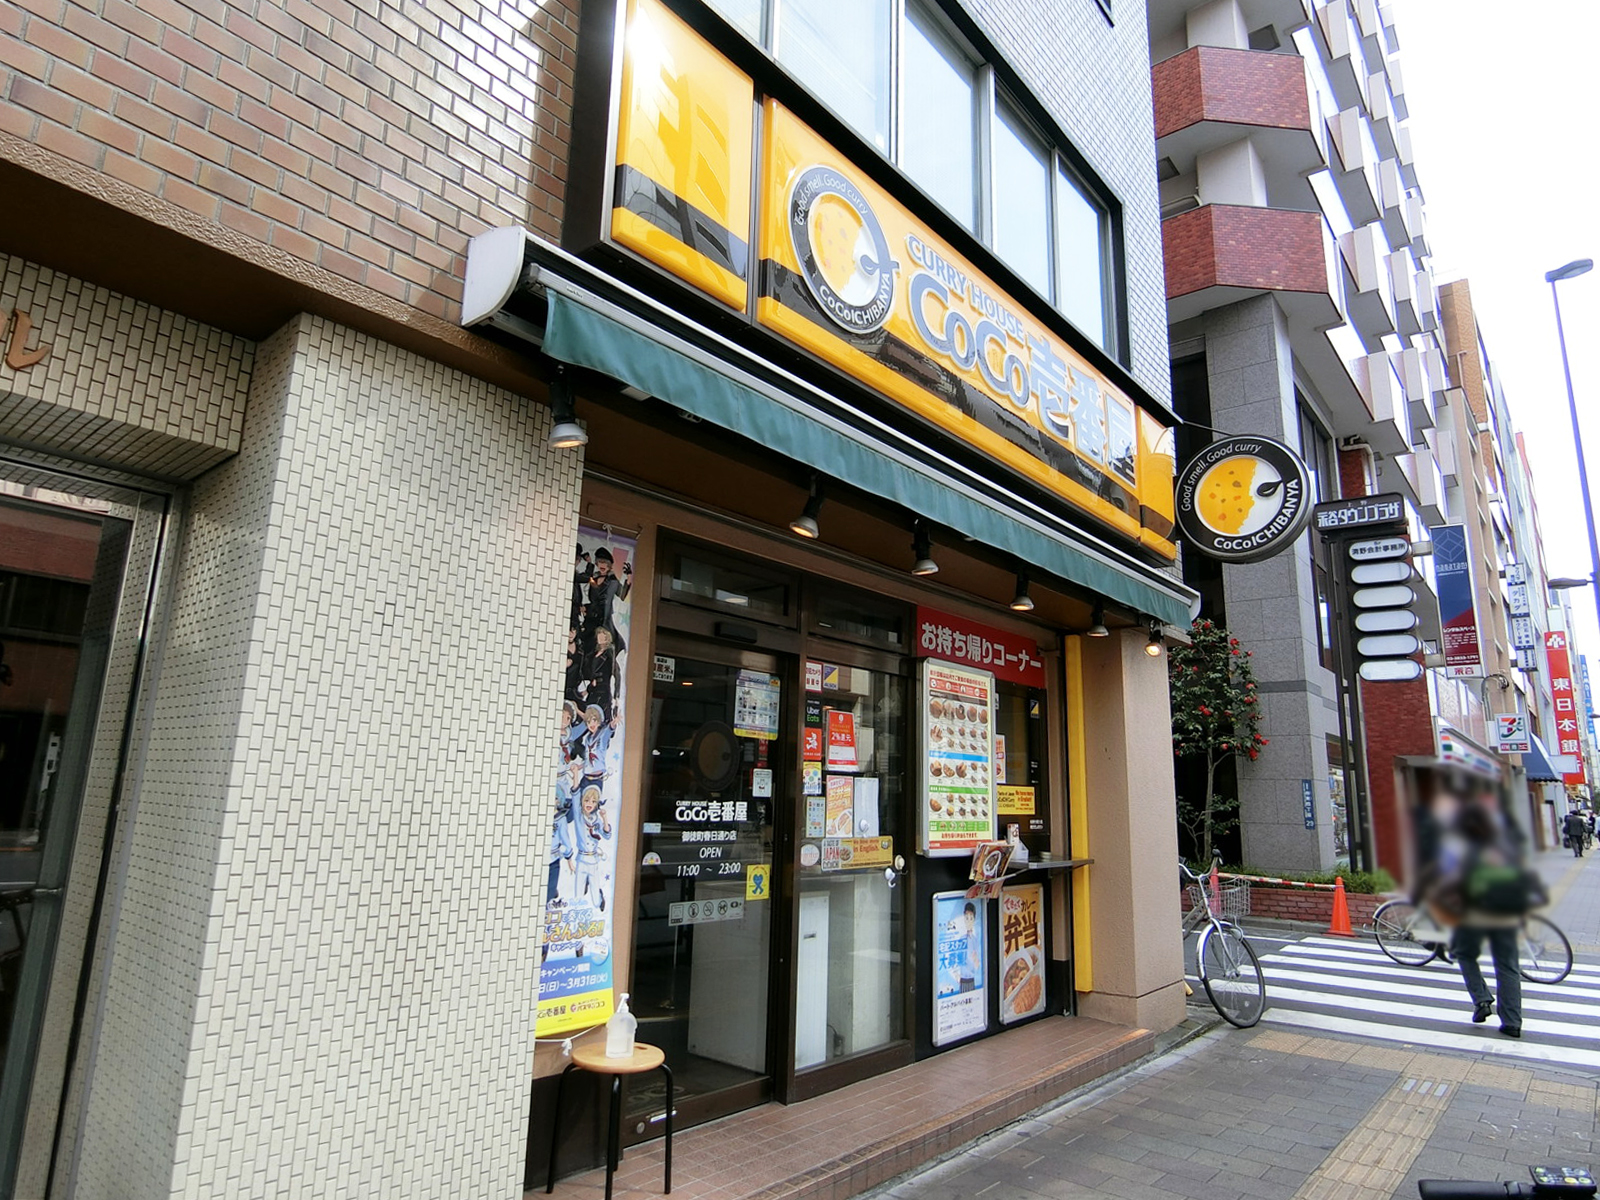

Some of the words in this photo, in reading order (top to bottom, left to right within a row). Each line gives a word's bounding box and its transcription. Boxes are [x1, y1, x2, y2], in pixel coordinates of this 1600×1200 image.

[823, 173, 847, 192] Good
[846, 188, 869, 215] curry
[908, 235, 967, 296] CURRY
[969, 281, 1025, 344] HOUSE
[909, 270, 1136, 488] CoCo壱番屋
[1181, 486, 1193, 512] Good
[1206, 443, 1233, 462] Good
[1234, 443, 1262, 454] curry
[921, 622, 1042, 672] お持ち帰りコーナー
[806, 706, 820, 715] Uber
[806, 714, 820, 722] Eats
[675, 800, 748, 821] CoCo壱番屋
[682, 830, 737, 842] 御徒町春日通り店
[699, 847, 722, 858] OPEN
[677, 864, 700, 877] 11:00
[718, 862, 741, 875] 23:00
[1004, 911, 1038, 956] 弁当
